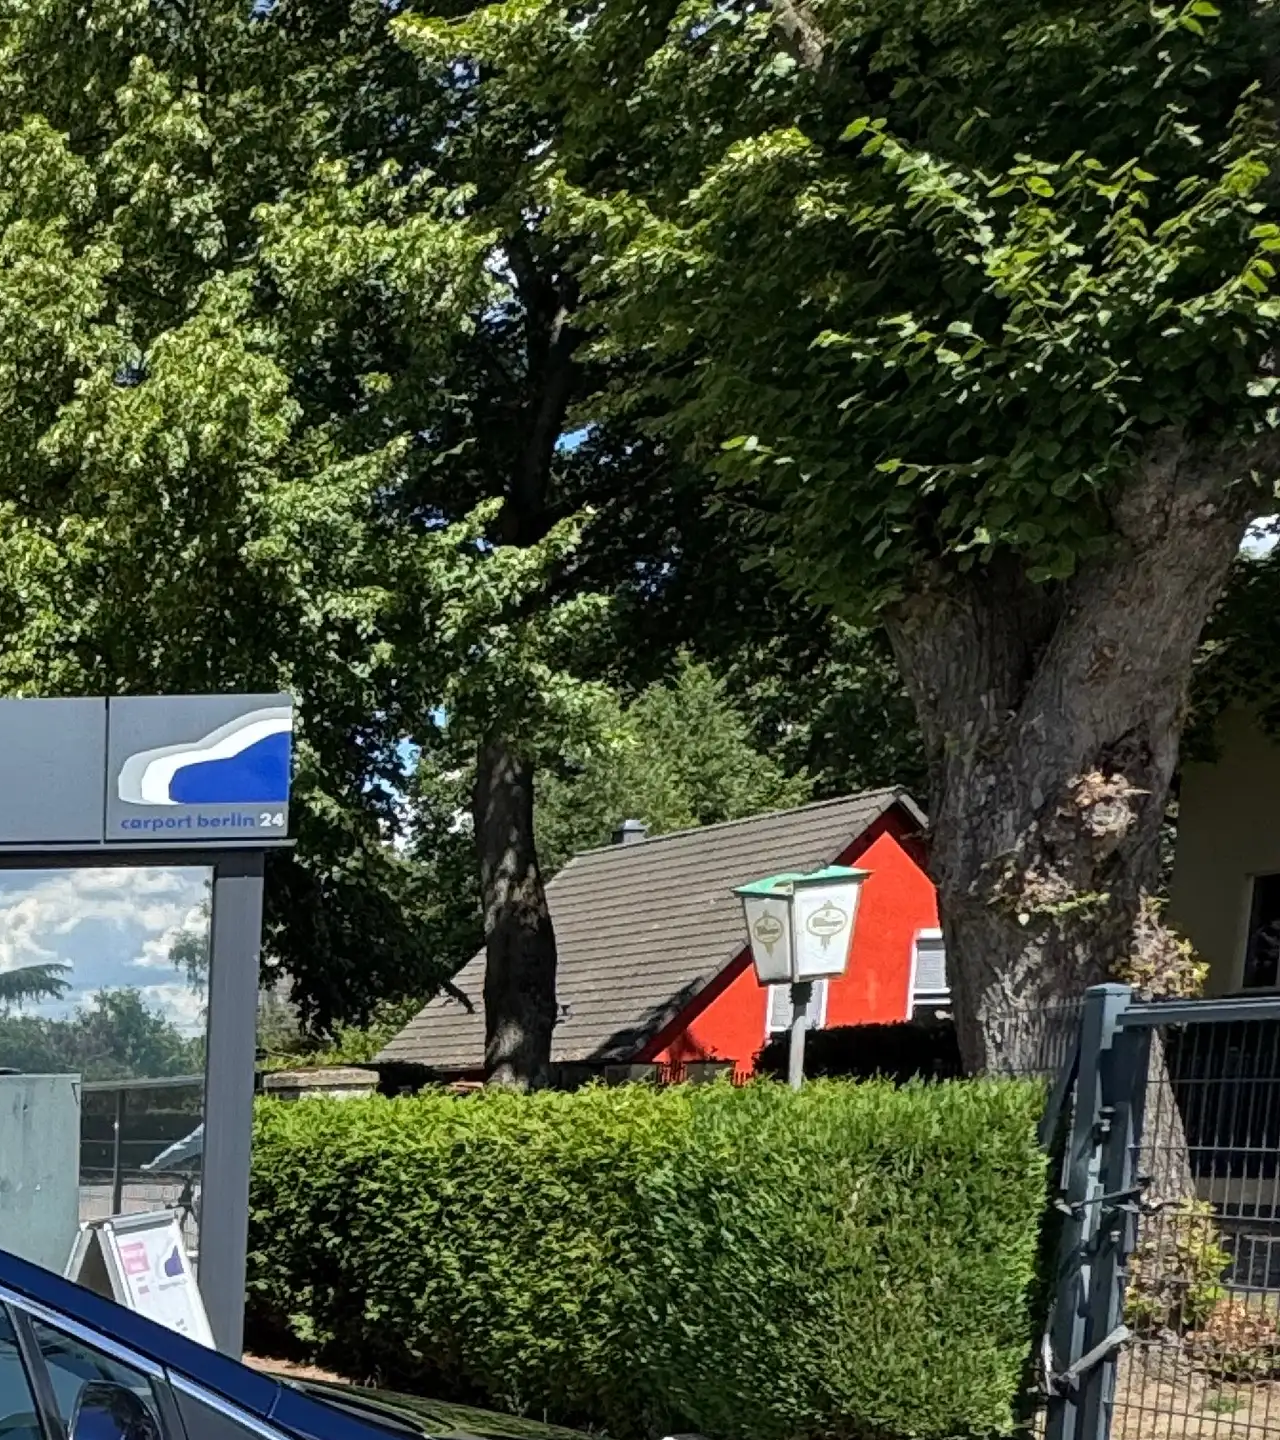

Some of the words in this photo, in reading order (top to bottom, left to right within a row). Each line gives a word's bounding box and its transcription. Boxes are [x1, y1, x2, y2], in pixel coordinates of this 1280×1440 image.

[120, 815, 191, 832] carport
[197, 812, 255, 828] berlin
[259, 812, 285, 827] 24
